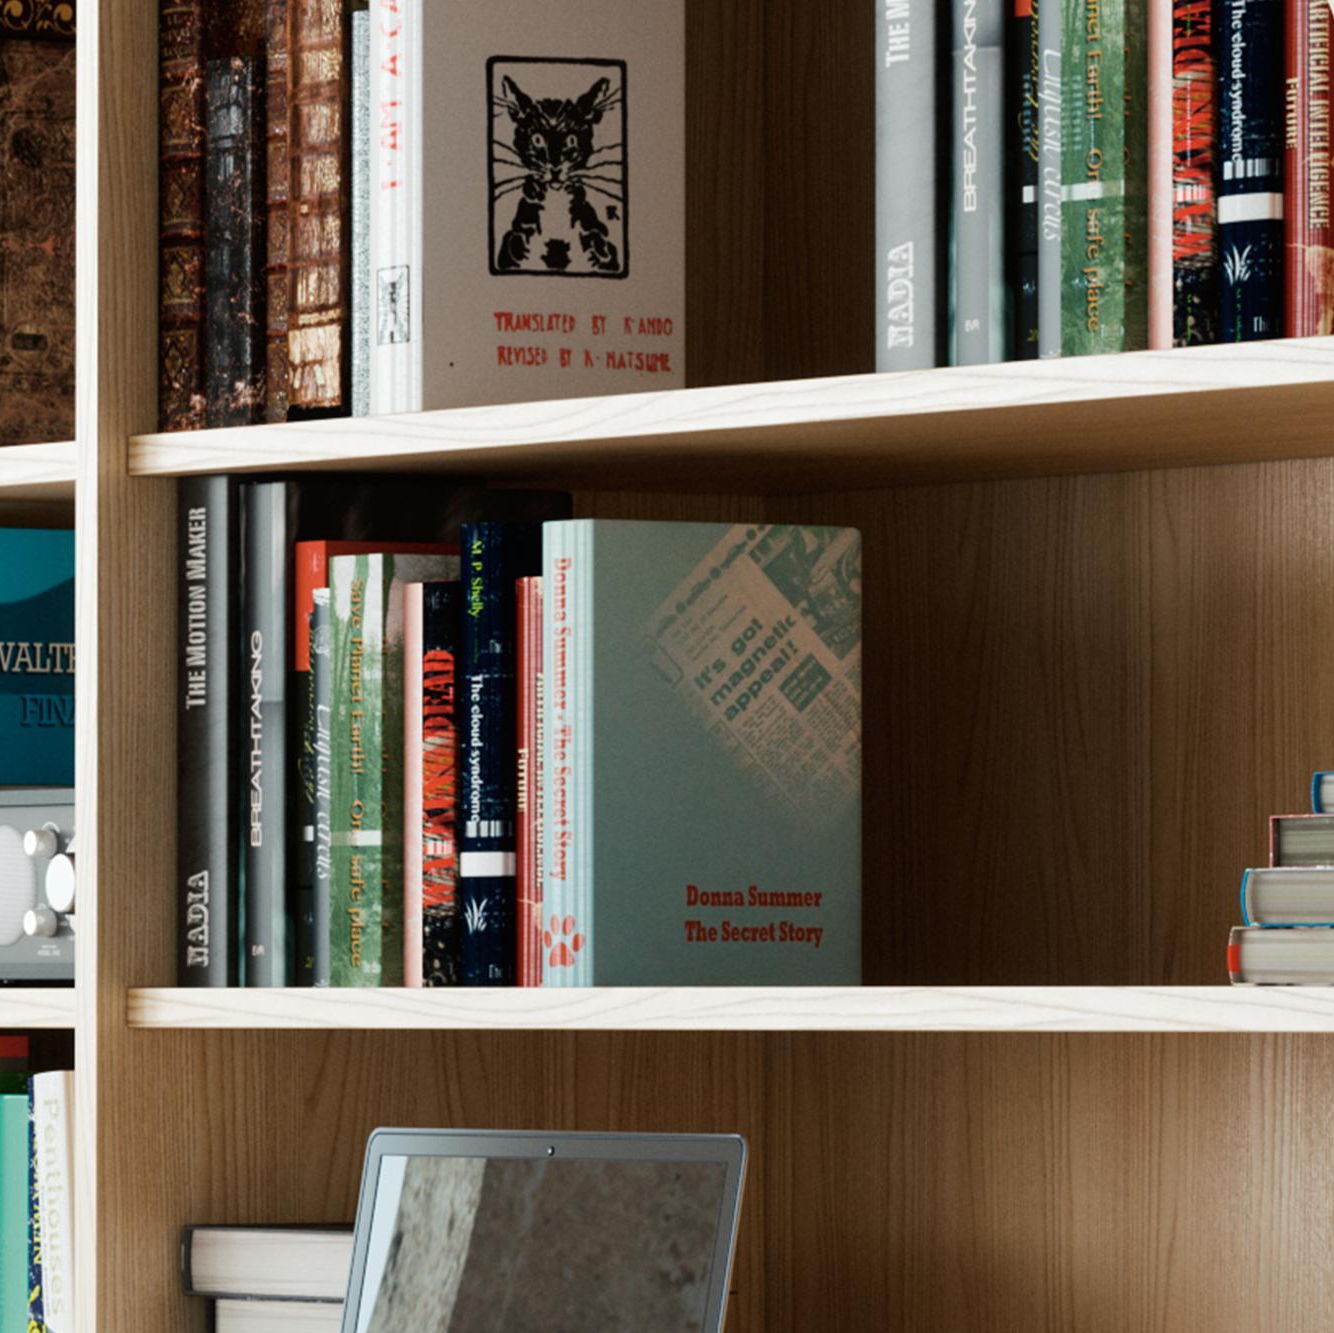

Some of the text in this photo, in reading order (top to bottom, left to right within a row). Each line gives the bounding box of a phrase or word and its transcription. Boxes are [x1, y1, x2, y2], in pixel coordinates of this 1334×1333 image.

[1229, 33, 1247, 78] cloud
[1229, 80, 1247, 164] syndrome
[592, 315, 605, 335] BY
[498, 347, 547, 366] REVISED
[560, 347, 571, 367] BY
[186, 506, 208, 710] THE MOTION MAKER
[731, 618, 763, 656] got
[710, 615, 795, 706] magnetic
[724, 640, 798, 721] appeal!
[250, 630, 263, 848] BREATHTAKING
[686, 884, 822, 907] Donna Summer
[685, 920, 823, 949] The Secret Story
